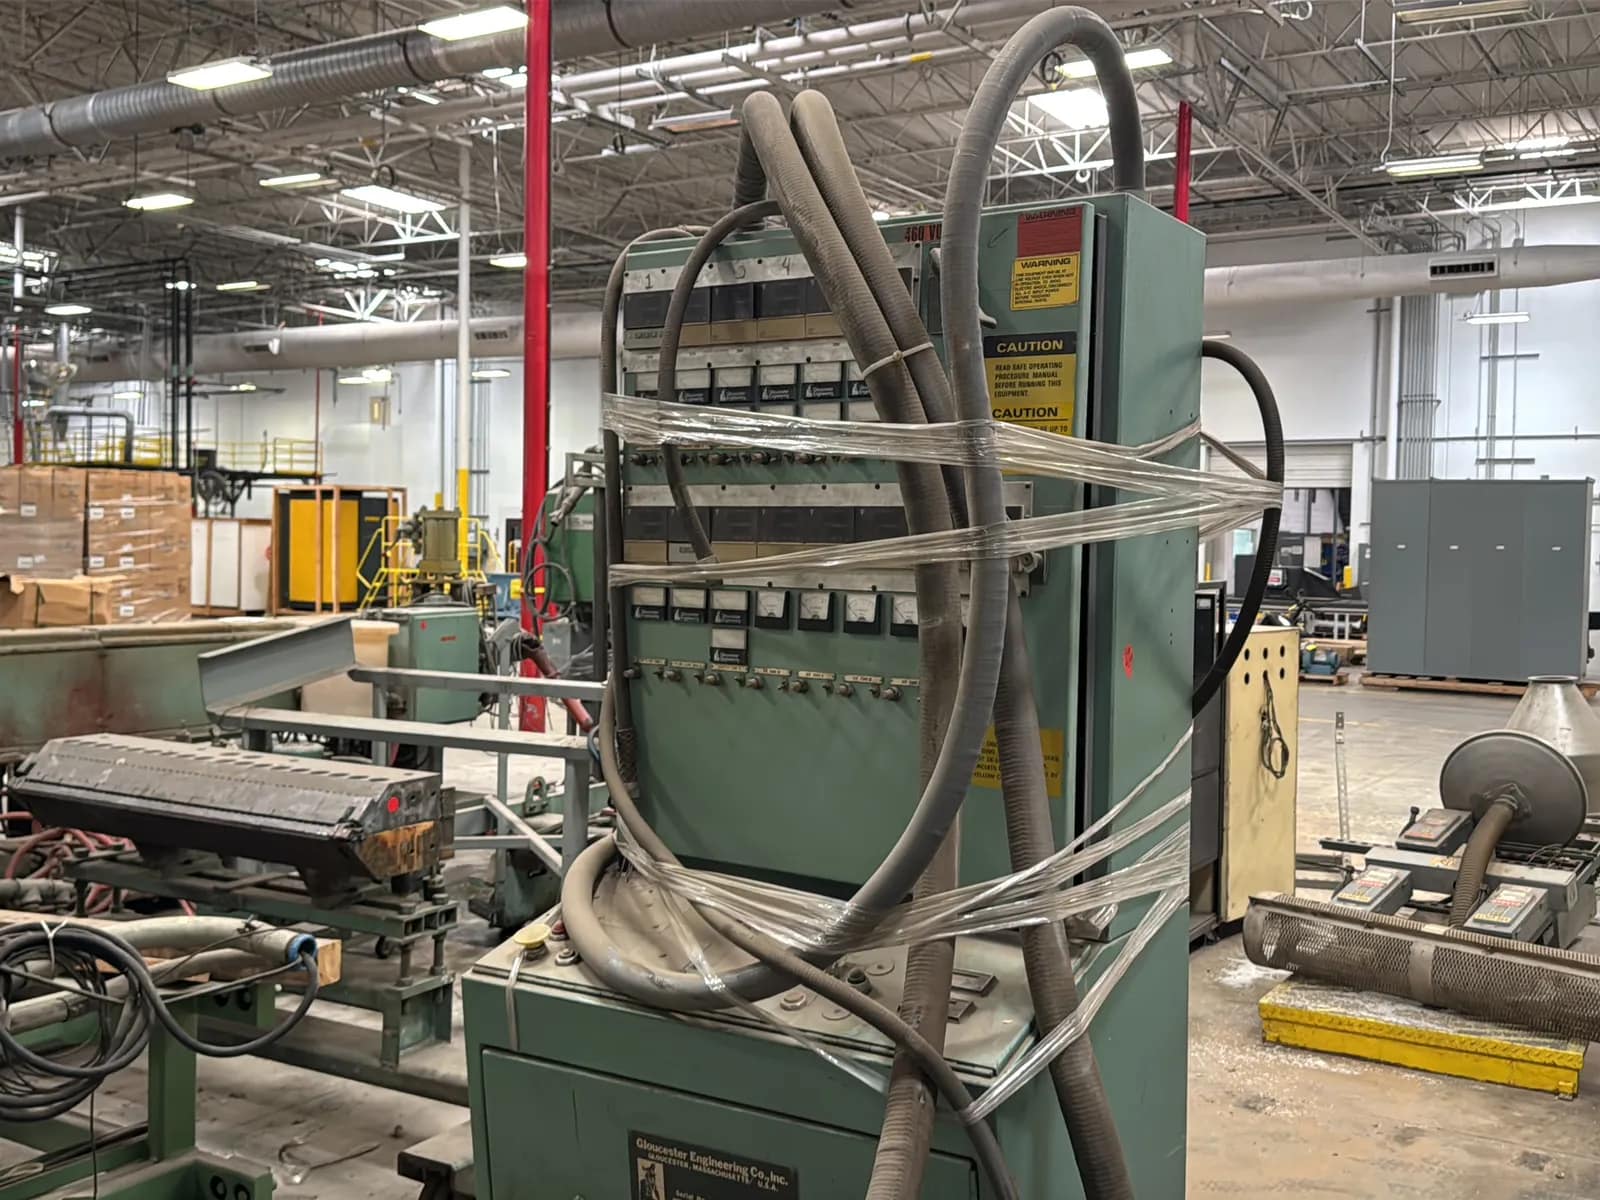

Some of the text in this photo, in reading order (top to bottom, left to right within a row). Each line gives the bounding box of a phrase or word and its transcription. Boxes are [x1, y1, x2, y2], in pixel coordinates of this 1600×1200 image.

[1025, 207, 1076, 221] WARNING
[1020, 257, 1071, 269] WARNING
[645, 274, 654, 290] 1
[782, 257, 791, 276] 4
[996, 340, 1064, 353] CAUTION
[995, 363, 1011, 371] READ
[1028, 361, 1063, 370] OPERATING
[995, 371, 1058, 381] PROCEDURE MANUAL
[994, 379, 1062, 390] BEFORE RUNNING THIS
[992, 407, 1058, 419] CAUTION
[636, 1137, 687, 1161] Gloucester
[690, 1151, 750, 1177] Engineering
[770, 1173, 789, 1186] Inc.
